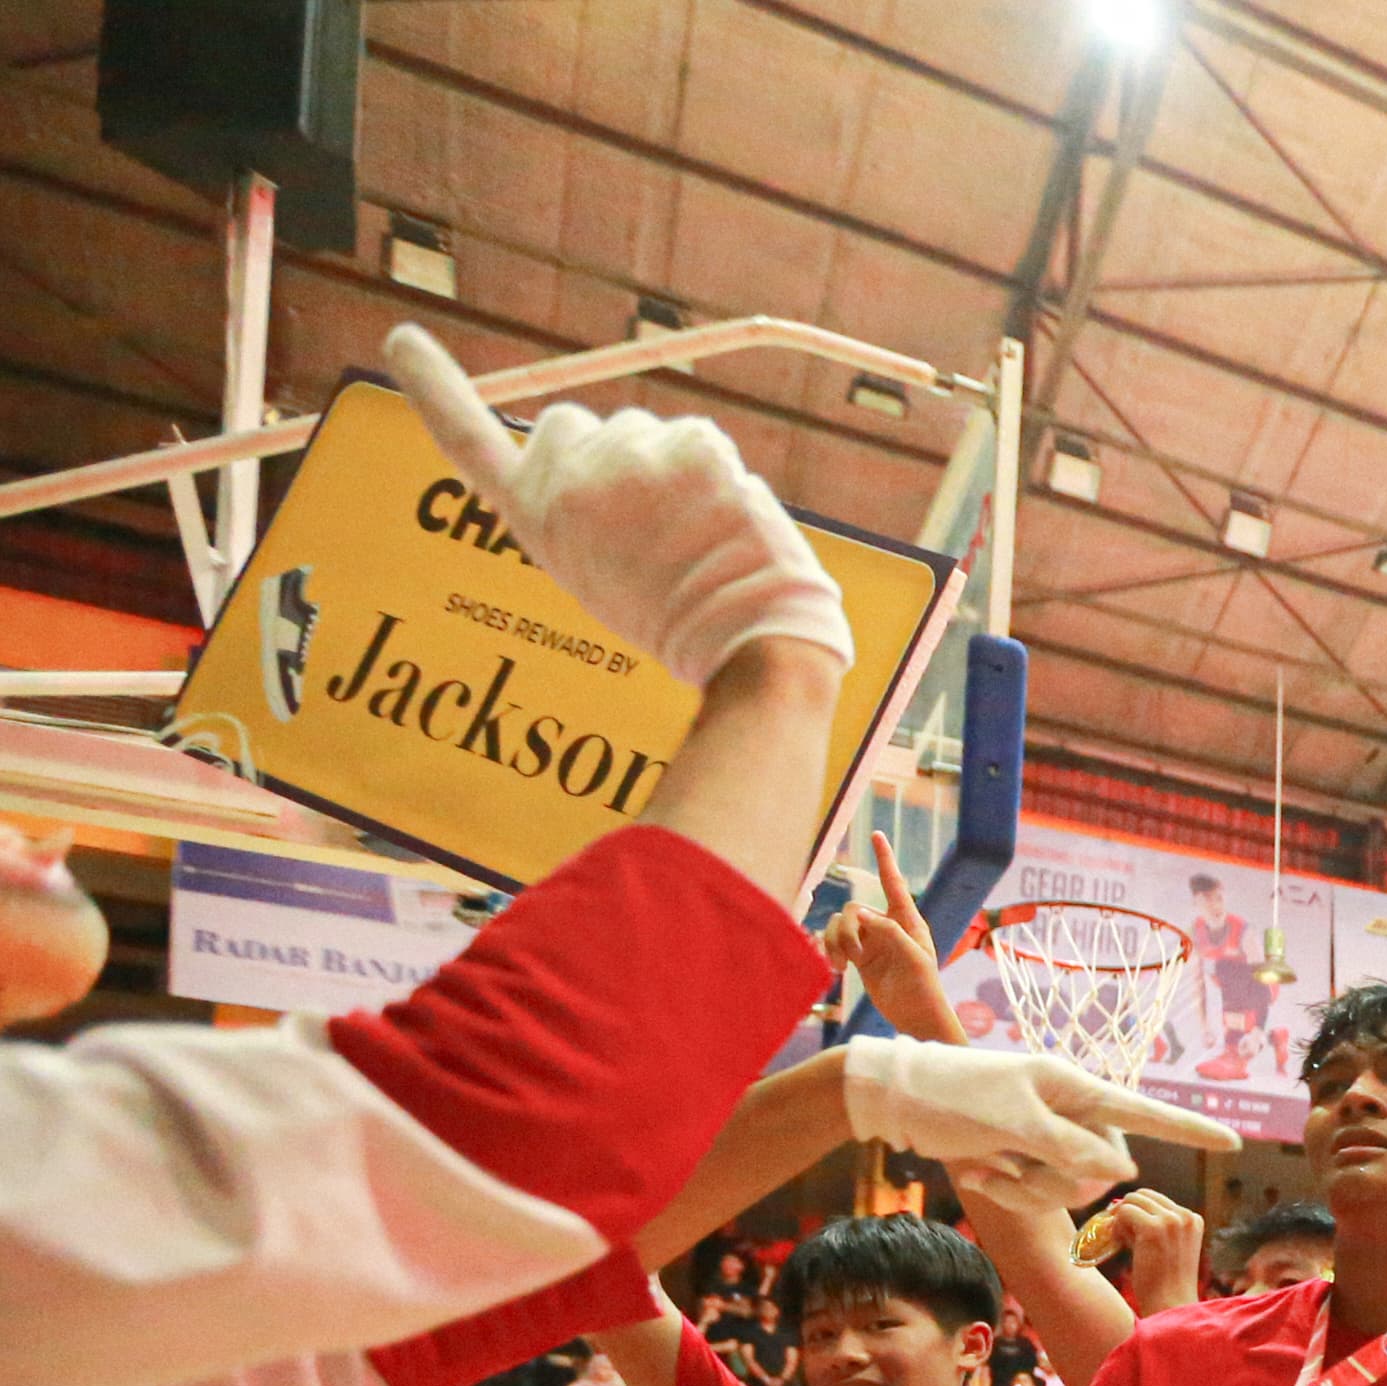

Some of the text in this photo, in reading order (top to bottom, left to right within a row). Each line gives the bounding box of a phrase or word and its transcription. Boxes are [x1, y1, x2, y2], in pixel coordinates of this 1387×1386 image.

[444, 592, 639, 678] SHOES REWARD BY
[1019, 865, 1127, 905] GEAR UP
[192, 928, 438, 984] RADAR BANJA
